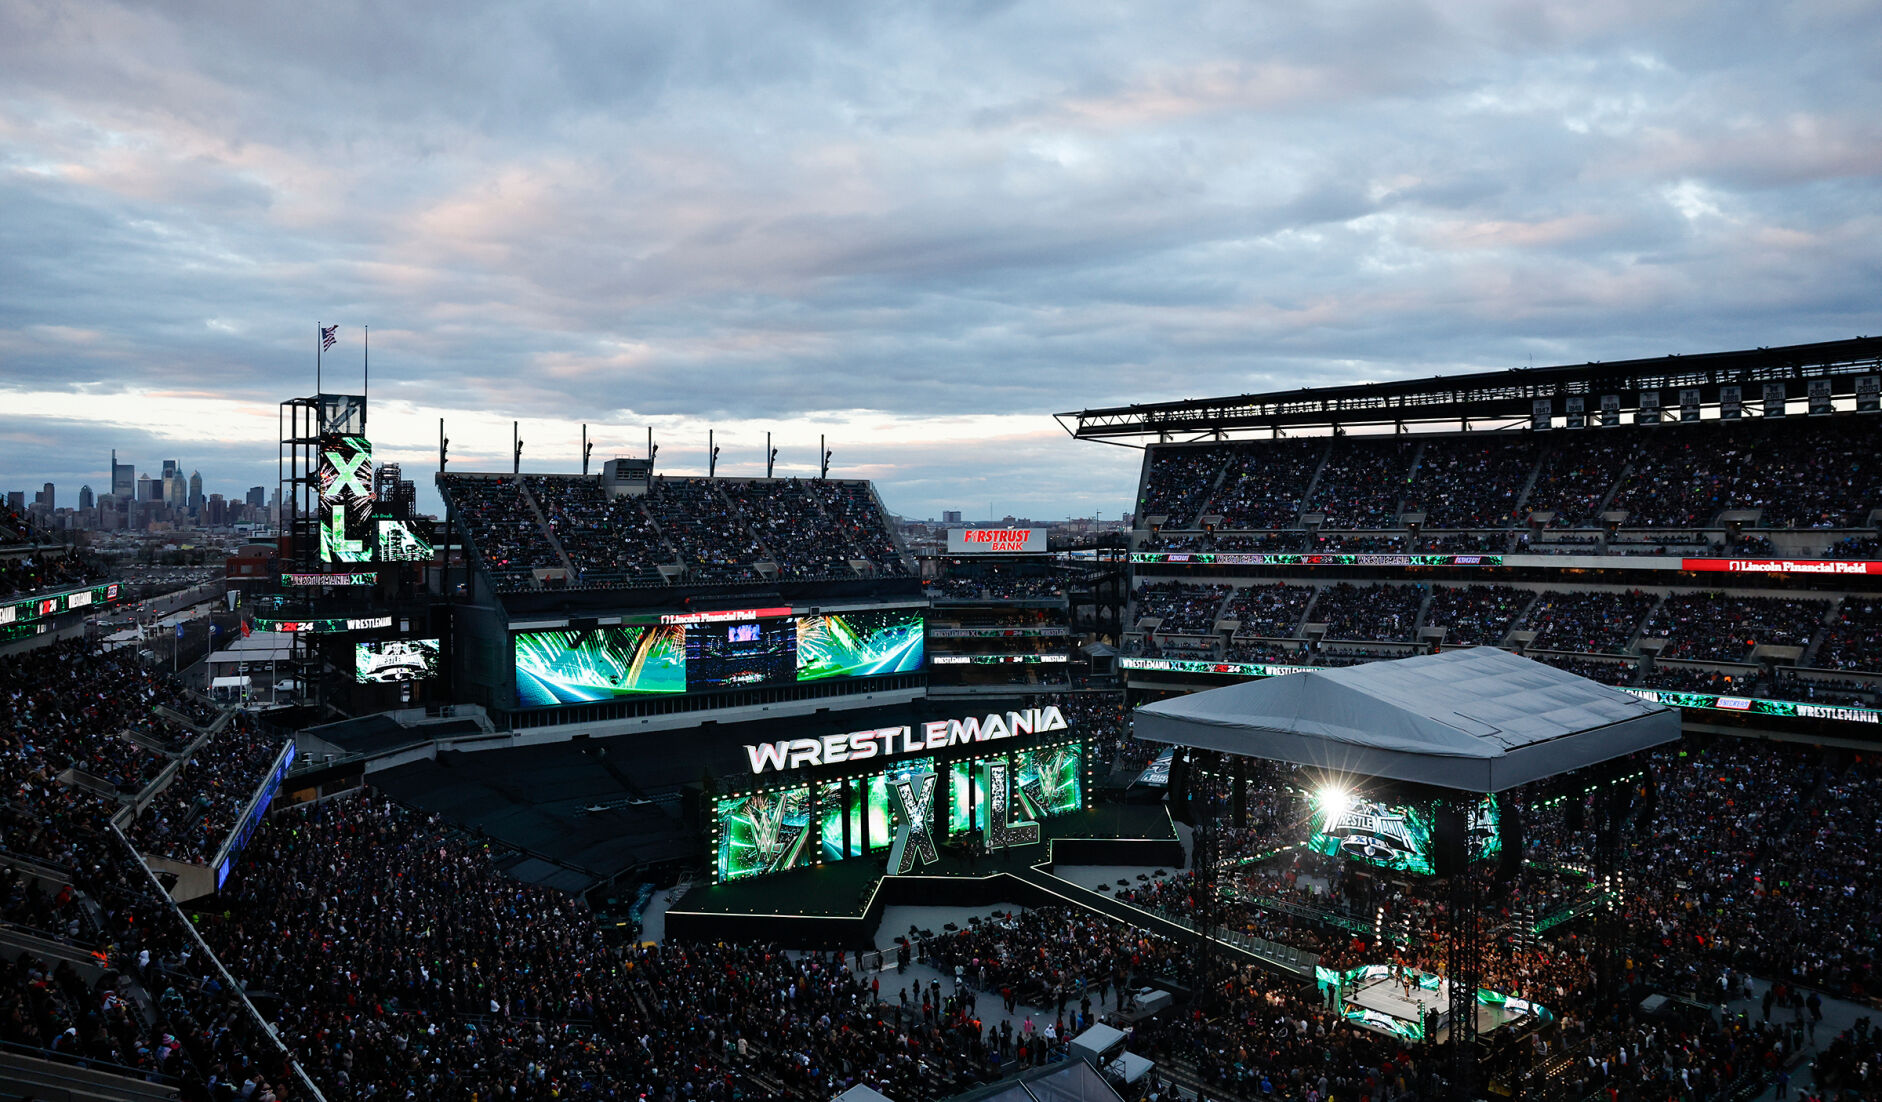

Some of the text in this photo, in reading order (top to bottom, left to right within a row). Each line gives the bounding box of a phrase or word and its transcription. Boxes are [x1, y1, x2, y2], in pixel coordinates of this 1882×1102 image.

[992, 542, 1023, 550] BANK
[1132, 554, 1144, 562] XL
[1264, 555, 1277, 564] XL
[1410, 556, 1424, 565] XL
[1741, 561, 1867, 573] Lincoln Financial Field
[350, 575, 365, 585] XL
[670, 610, 757, 625] Lincoln Financial Field
[1122, 659, 1170, 670] WRESTLEMANIA
[1659, 692, 1677, 704] XL
[1717, 698, 1749, 708] SNICKERS
[1797, 704, 1879, 724] WRESTLEMANIA
[744, 706, 1068, 774] WRESTLEMANIA
